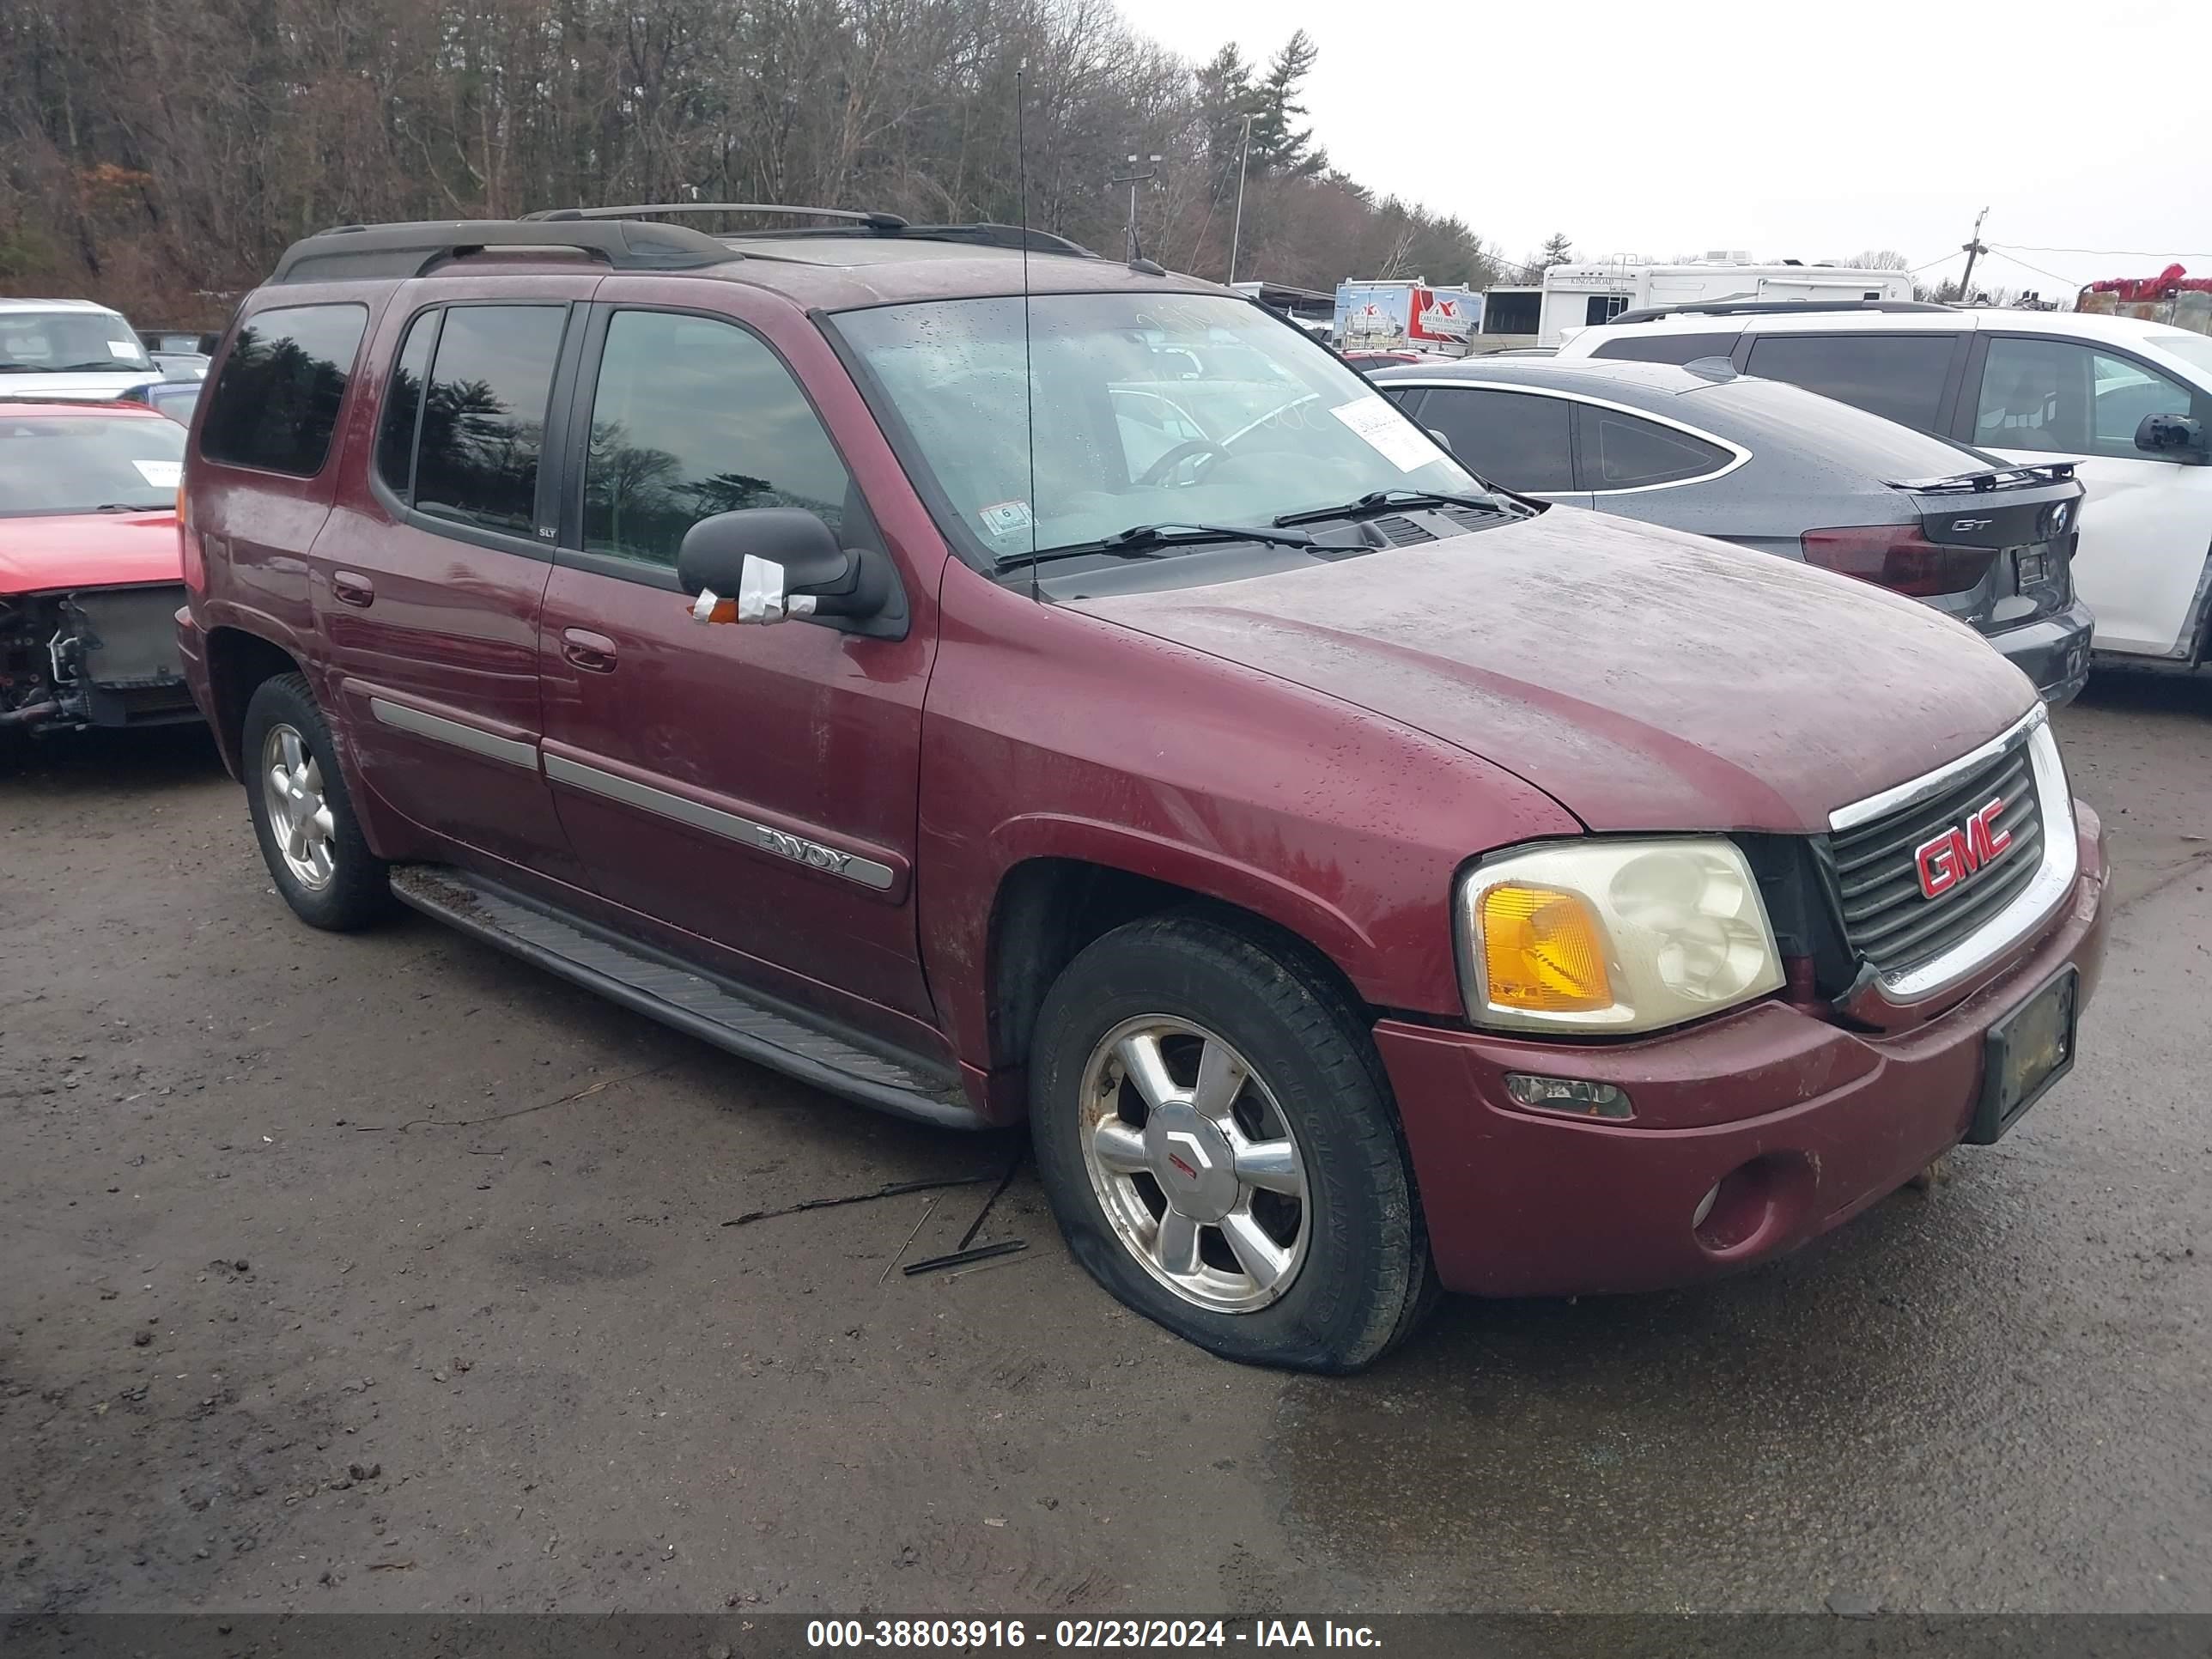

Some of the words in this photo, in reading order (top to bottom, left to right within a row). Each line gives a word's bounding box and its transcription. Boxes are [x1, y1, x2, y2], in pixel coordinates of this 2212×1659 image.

[538, 528, 556, 538] SLT
[1952, 519, 1993, 532] GT
[756, 826, 853, 874] ENVOY
[1915, 797, 2012, 900] GMC
